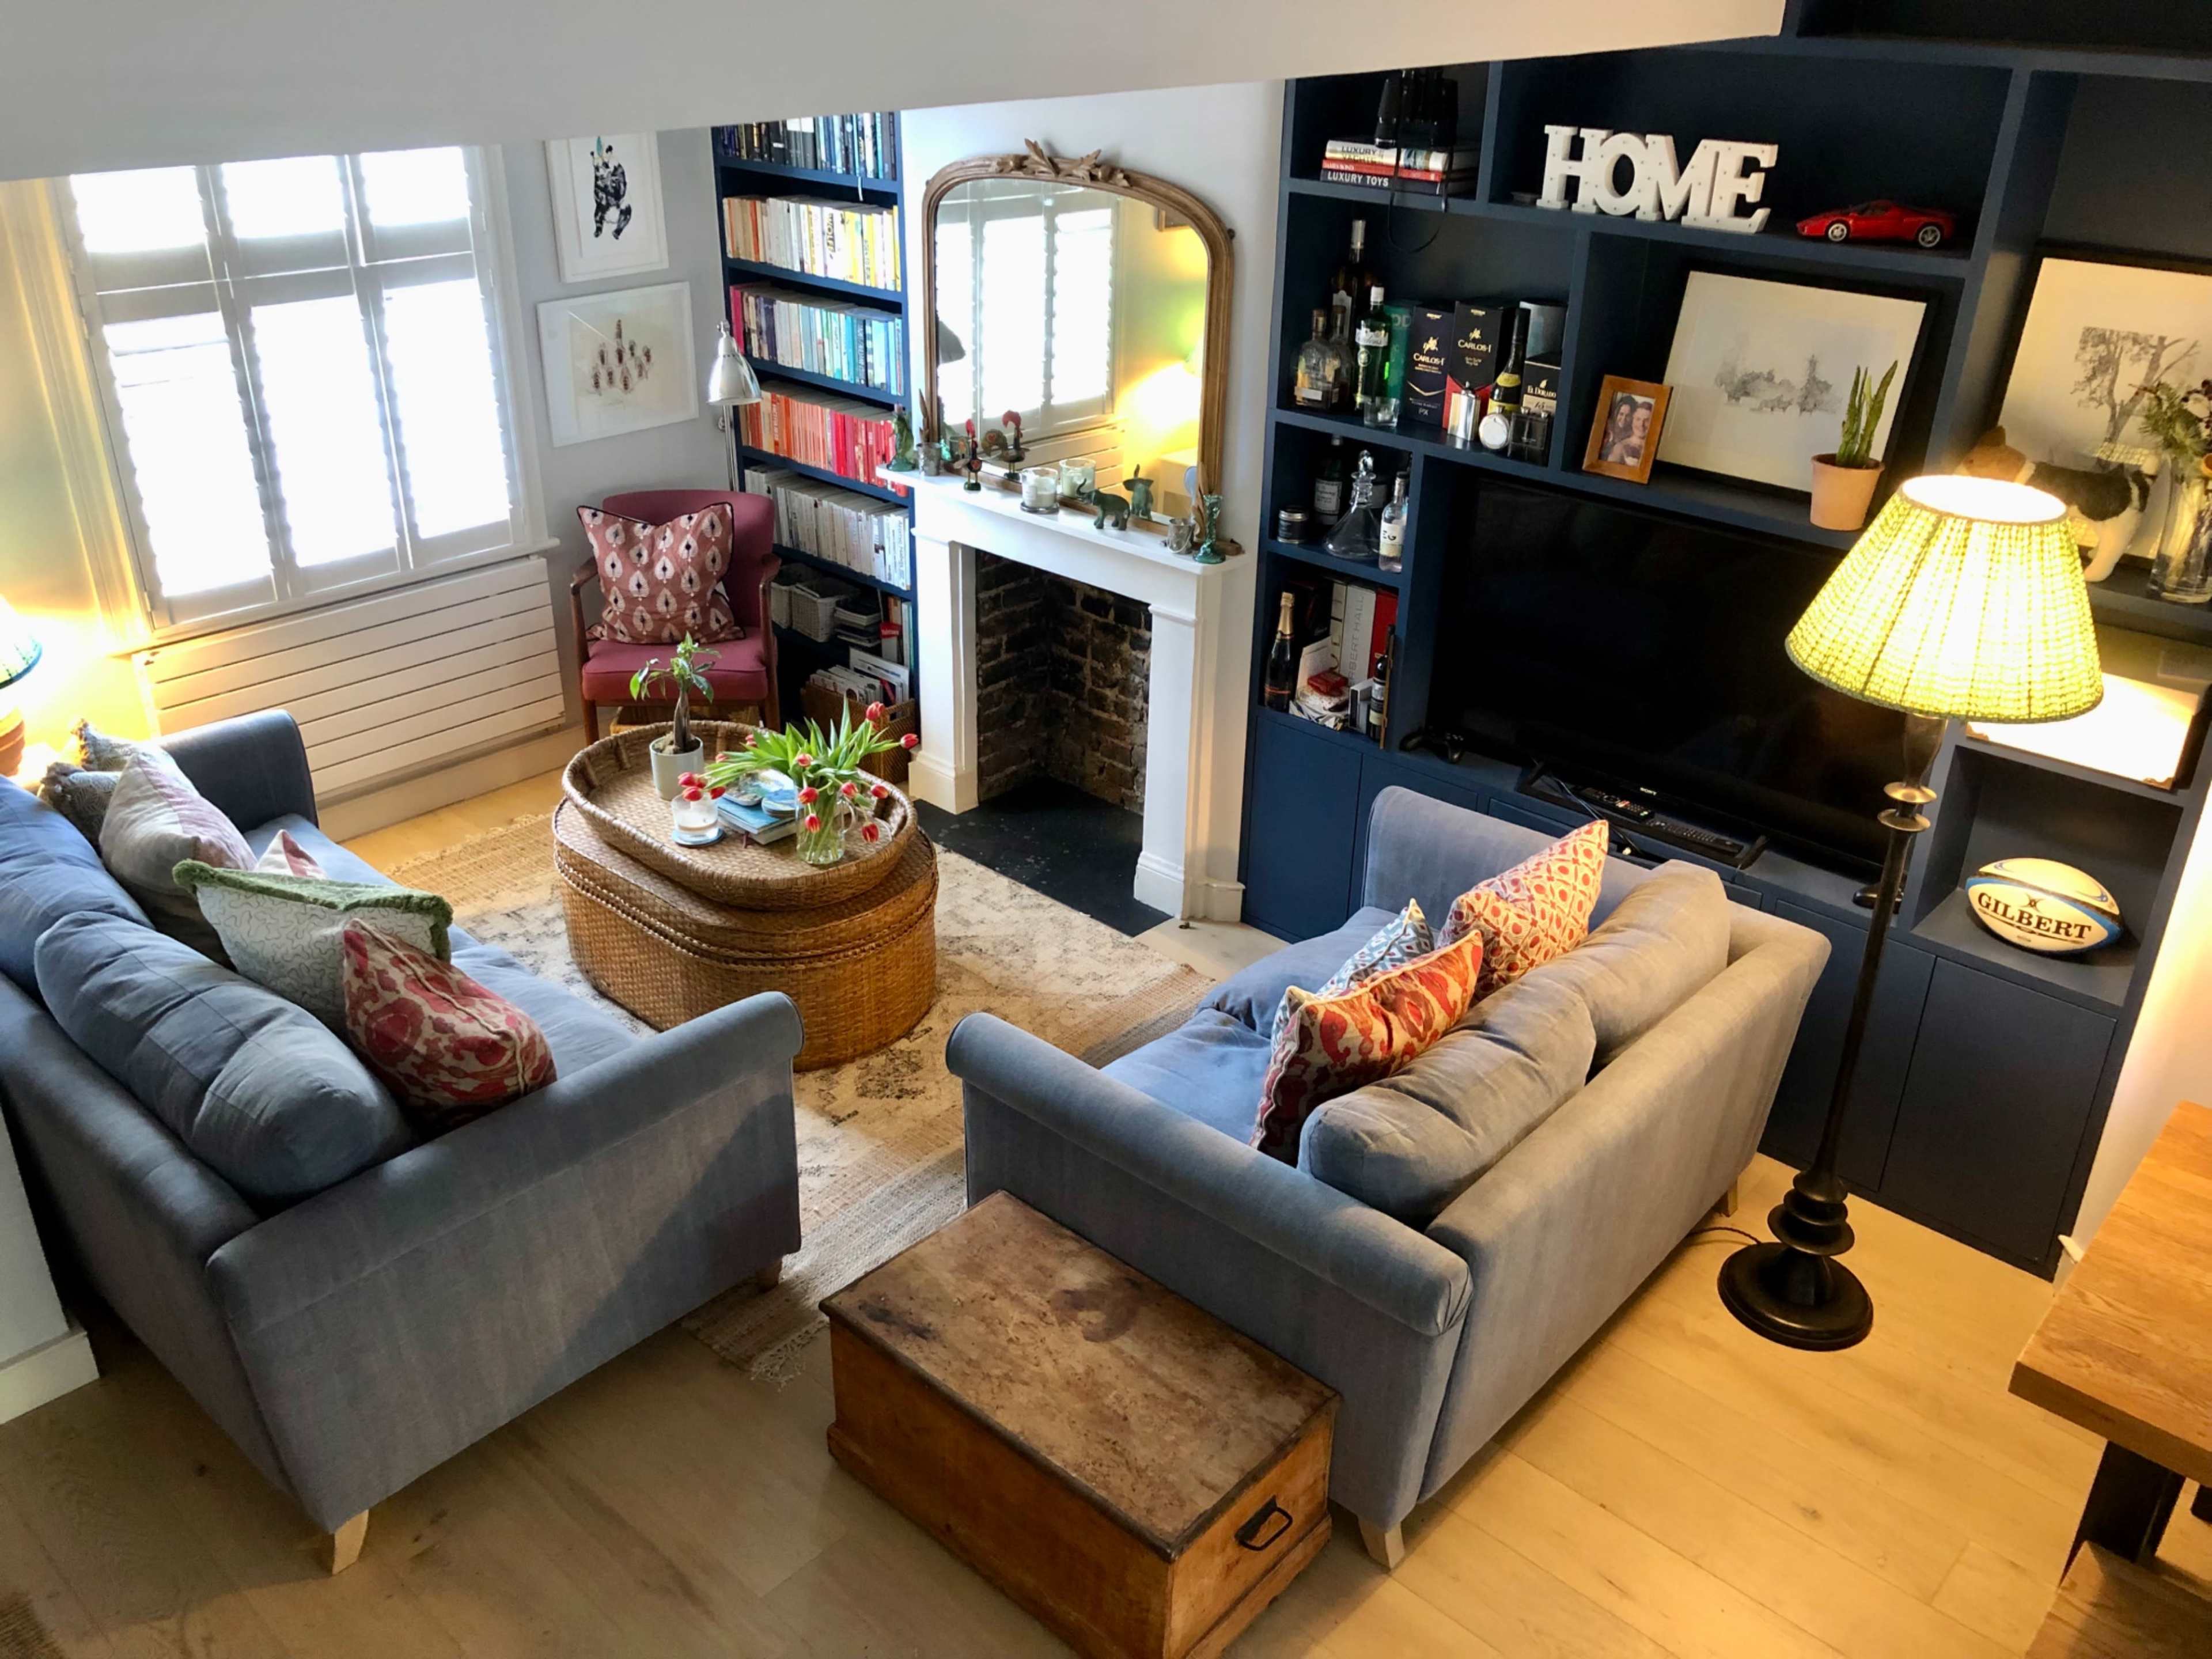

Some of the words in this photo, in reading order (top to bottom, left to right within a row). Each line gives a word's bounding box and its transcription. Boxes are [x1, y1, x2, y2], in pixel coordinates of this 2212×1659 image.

[1342, 146, 1377, 155] LUXURY
[1328, 172, 1363, 183] LUXURY
[1366, 176, 1389, 187] TOYS
[1536, 124, 1778, 233] HOME
[1978, 893, 2092, 939] GILBERT
